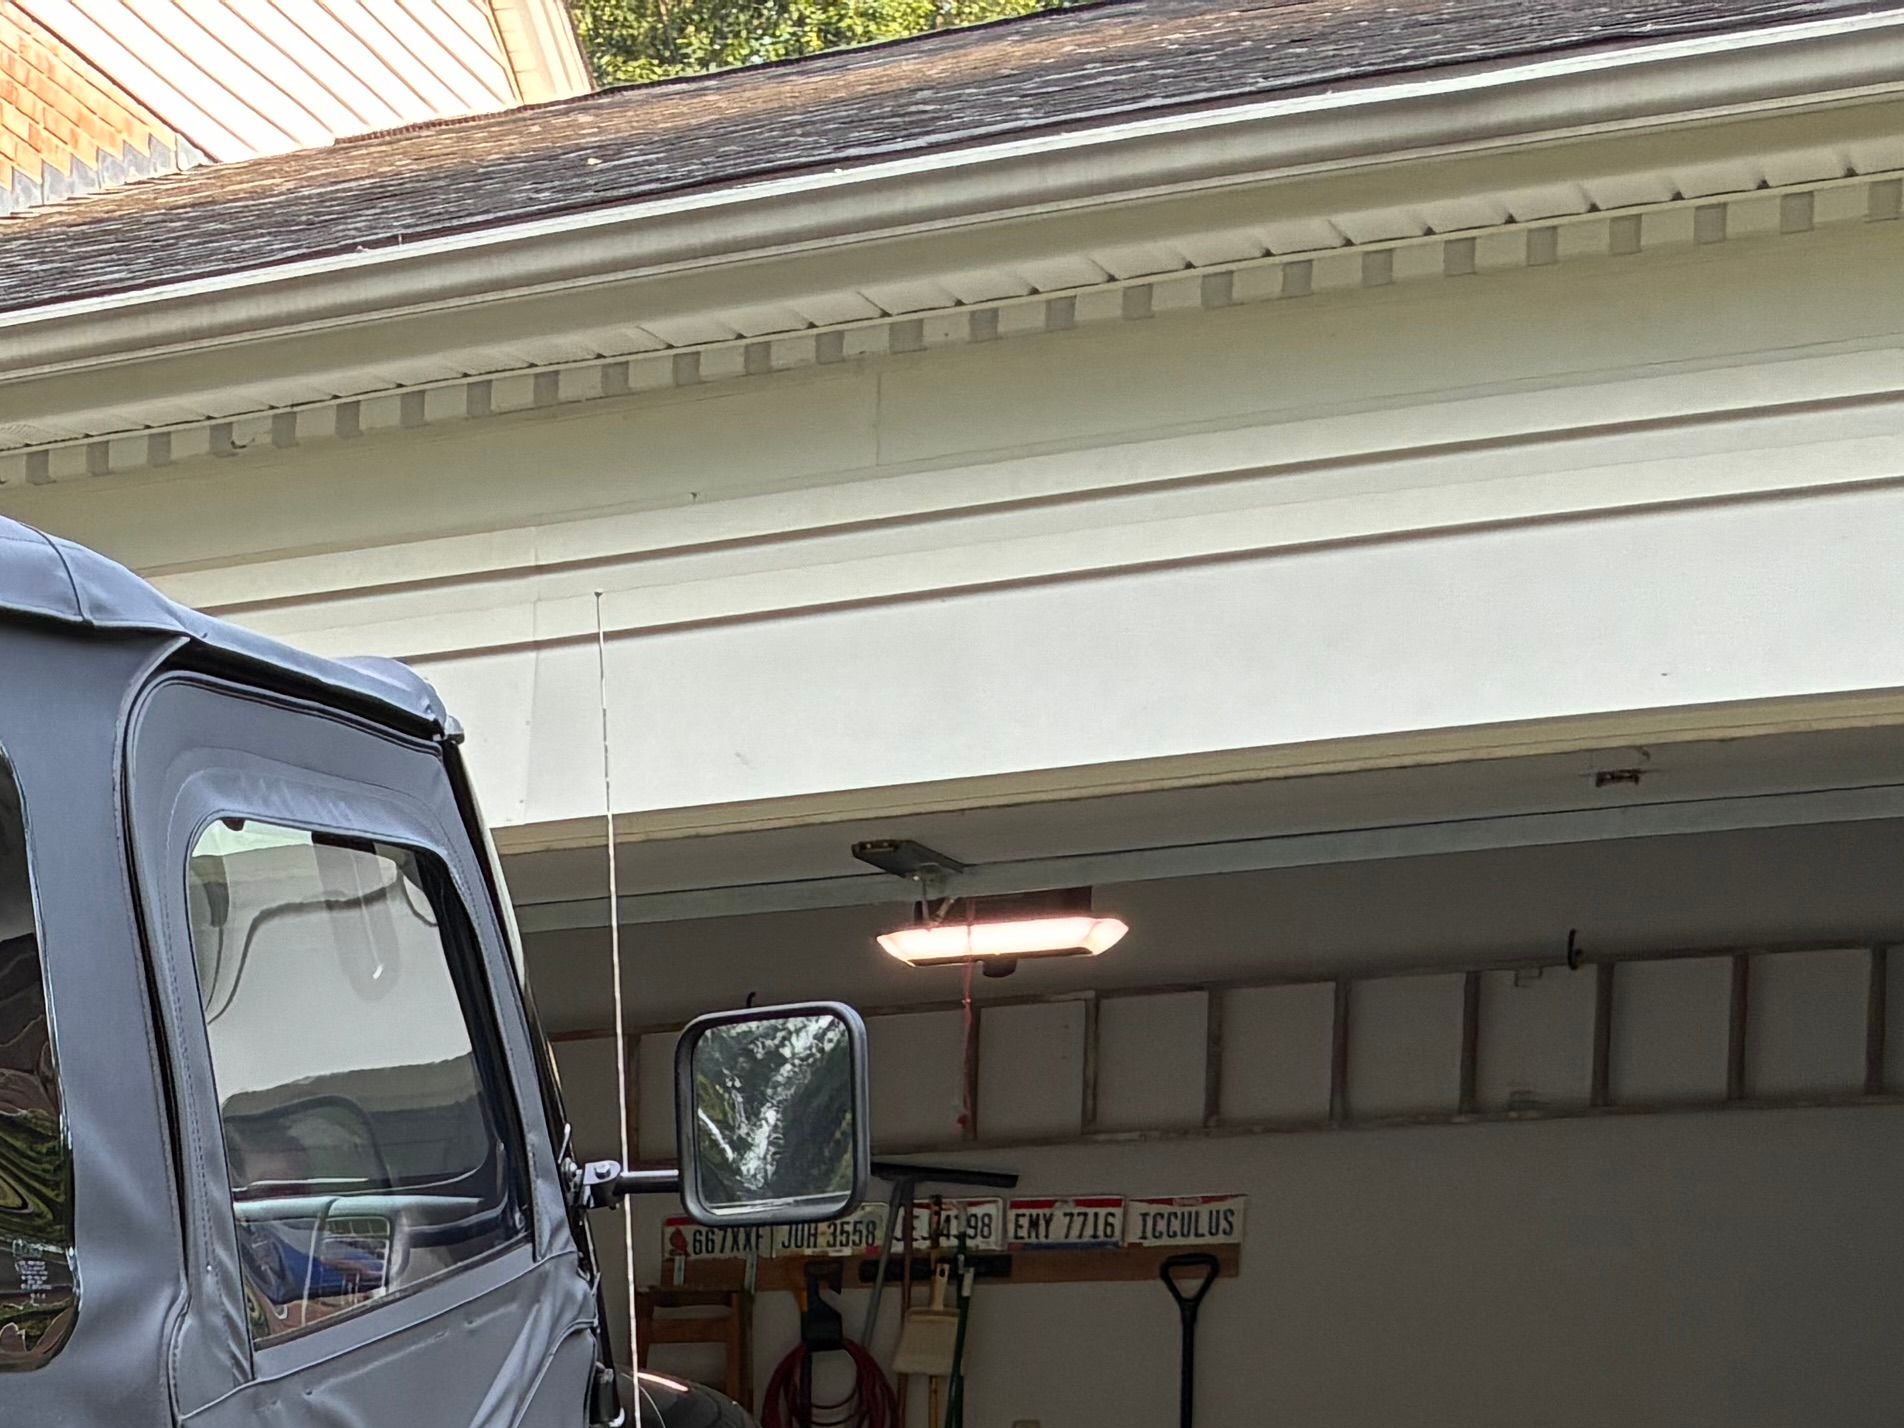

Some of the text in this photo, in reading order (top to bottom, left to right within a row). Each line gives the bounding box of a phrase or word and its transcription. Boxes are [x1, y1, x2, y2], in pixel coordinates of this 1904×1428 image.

[826, 1220, 877, 1248] 3558
[1014, 1211, 1117, 1241] EMY 7716
[1138, 1208, 1236, 1240] ICCULUS
